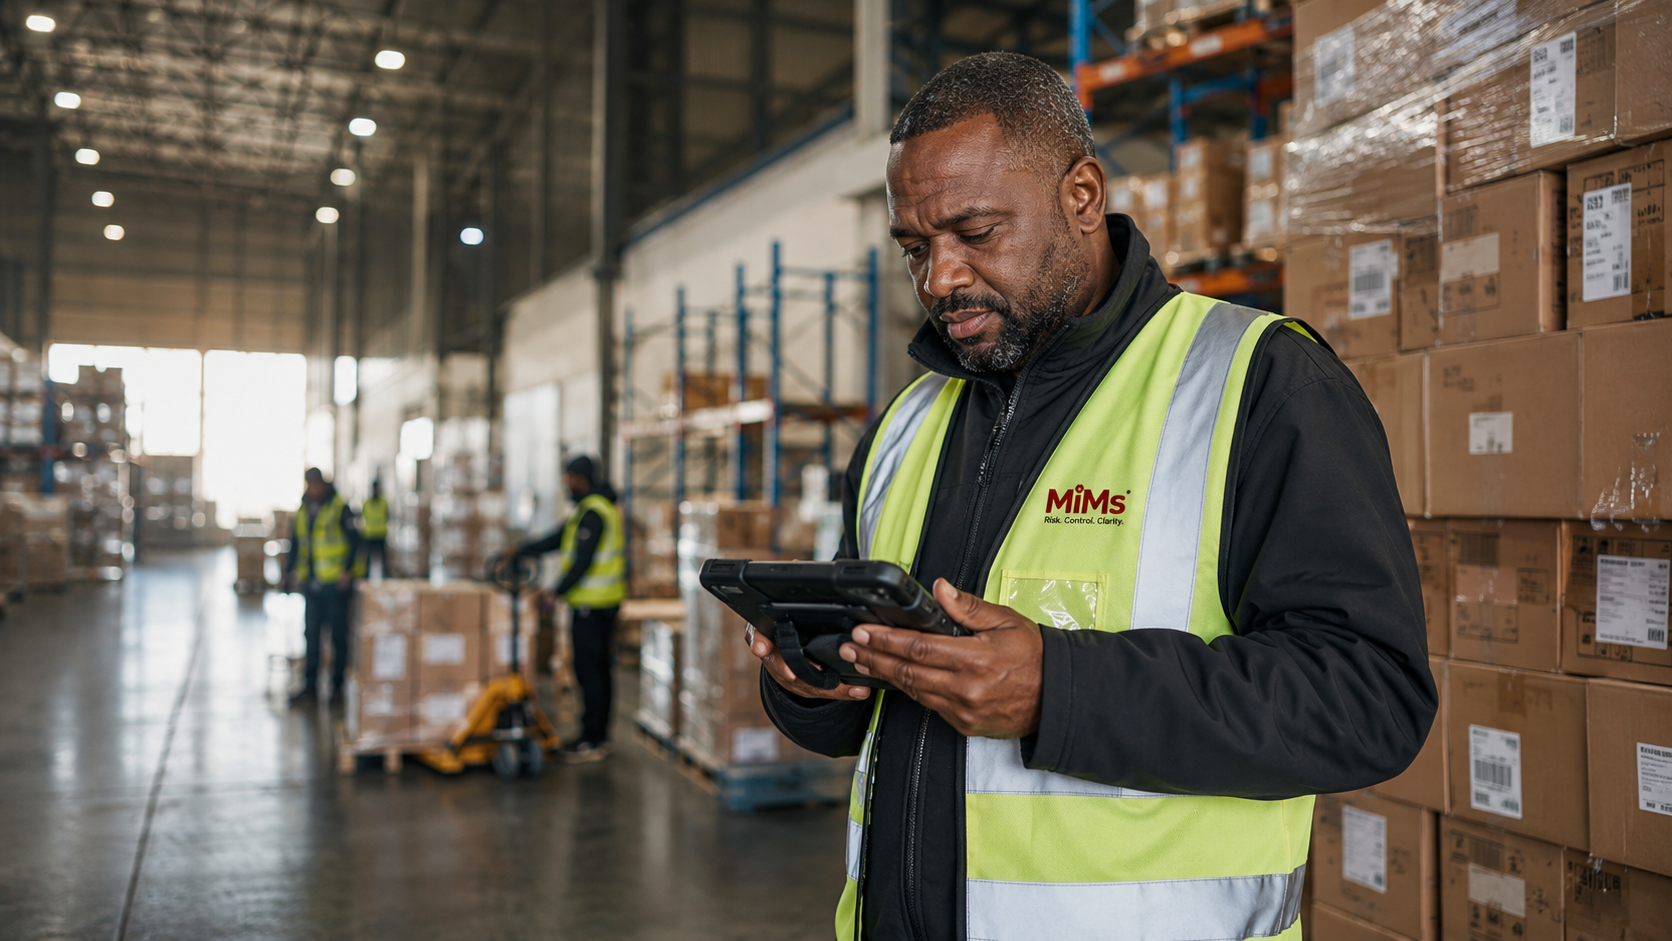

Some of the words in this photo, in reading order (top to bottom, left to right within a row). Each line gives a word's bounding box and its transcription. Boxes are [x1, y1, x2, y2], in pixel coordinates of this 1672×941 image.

[1045, 484, 1126, 514] MiMs
[1044, 516, 1062, 524] Risk.
[1064, 516, 1095, 525] Control.
[1097, 517, 1124, 526] Clarity.
